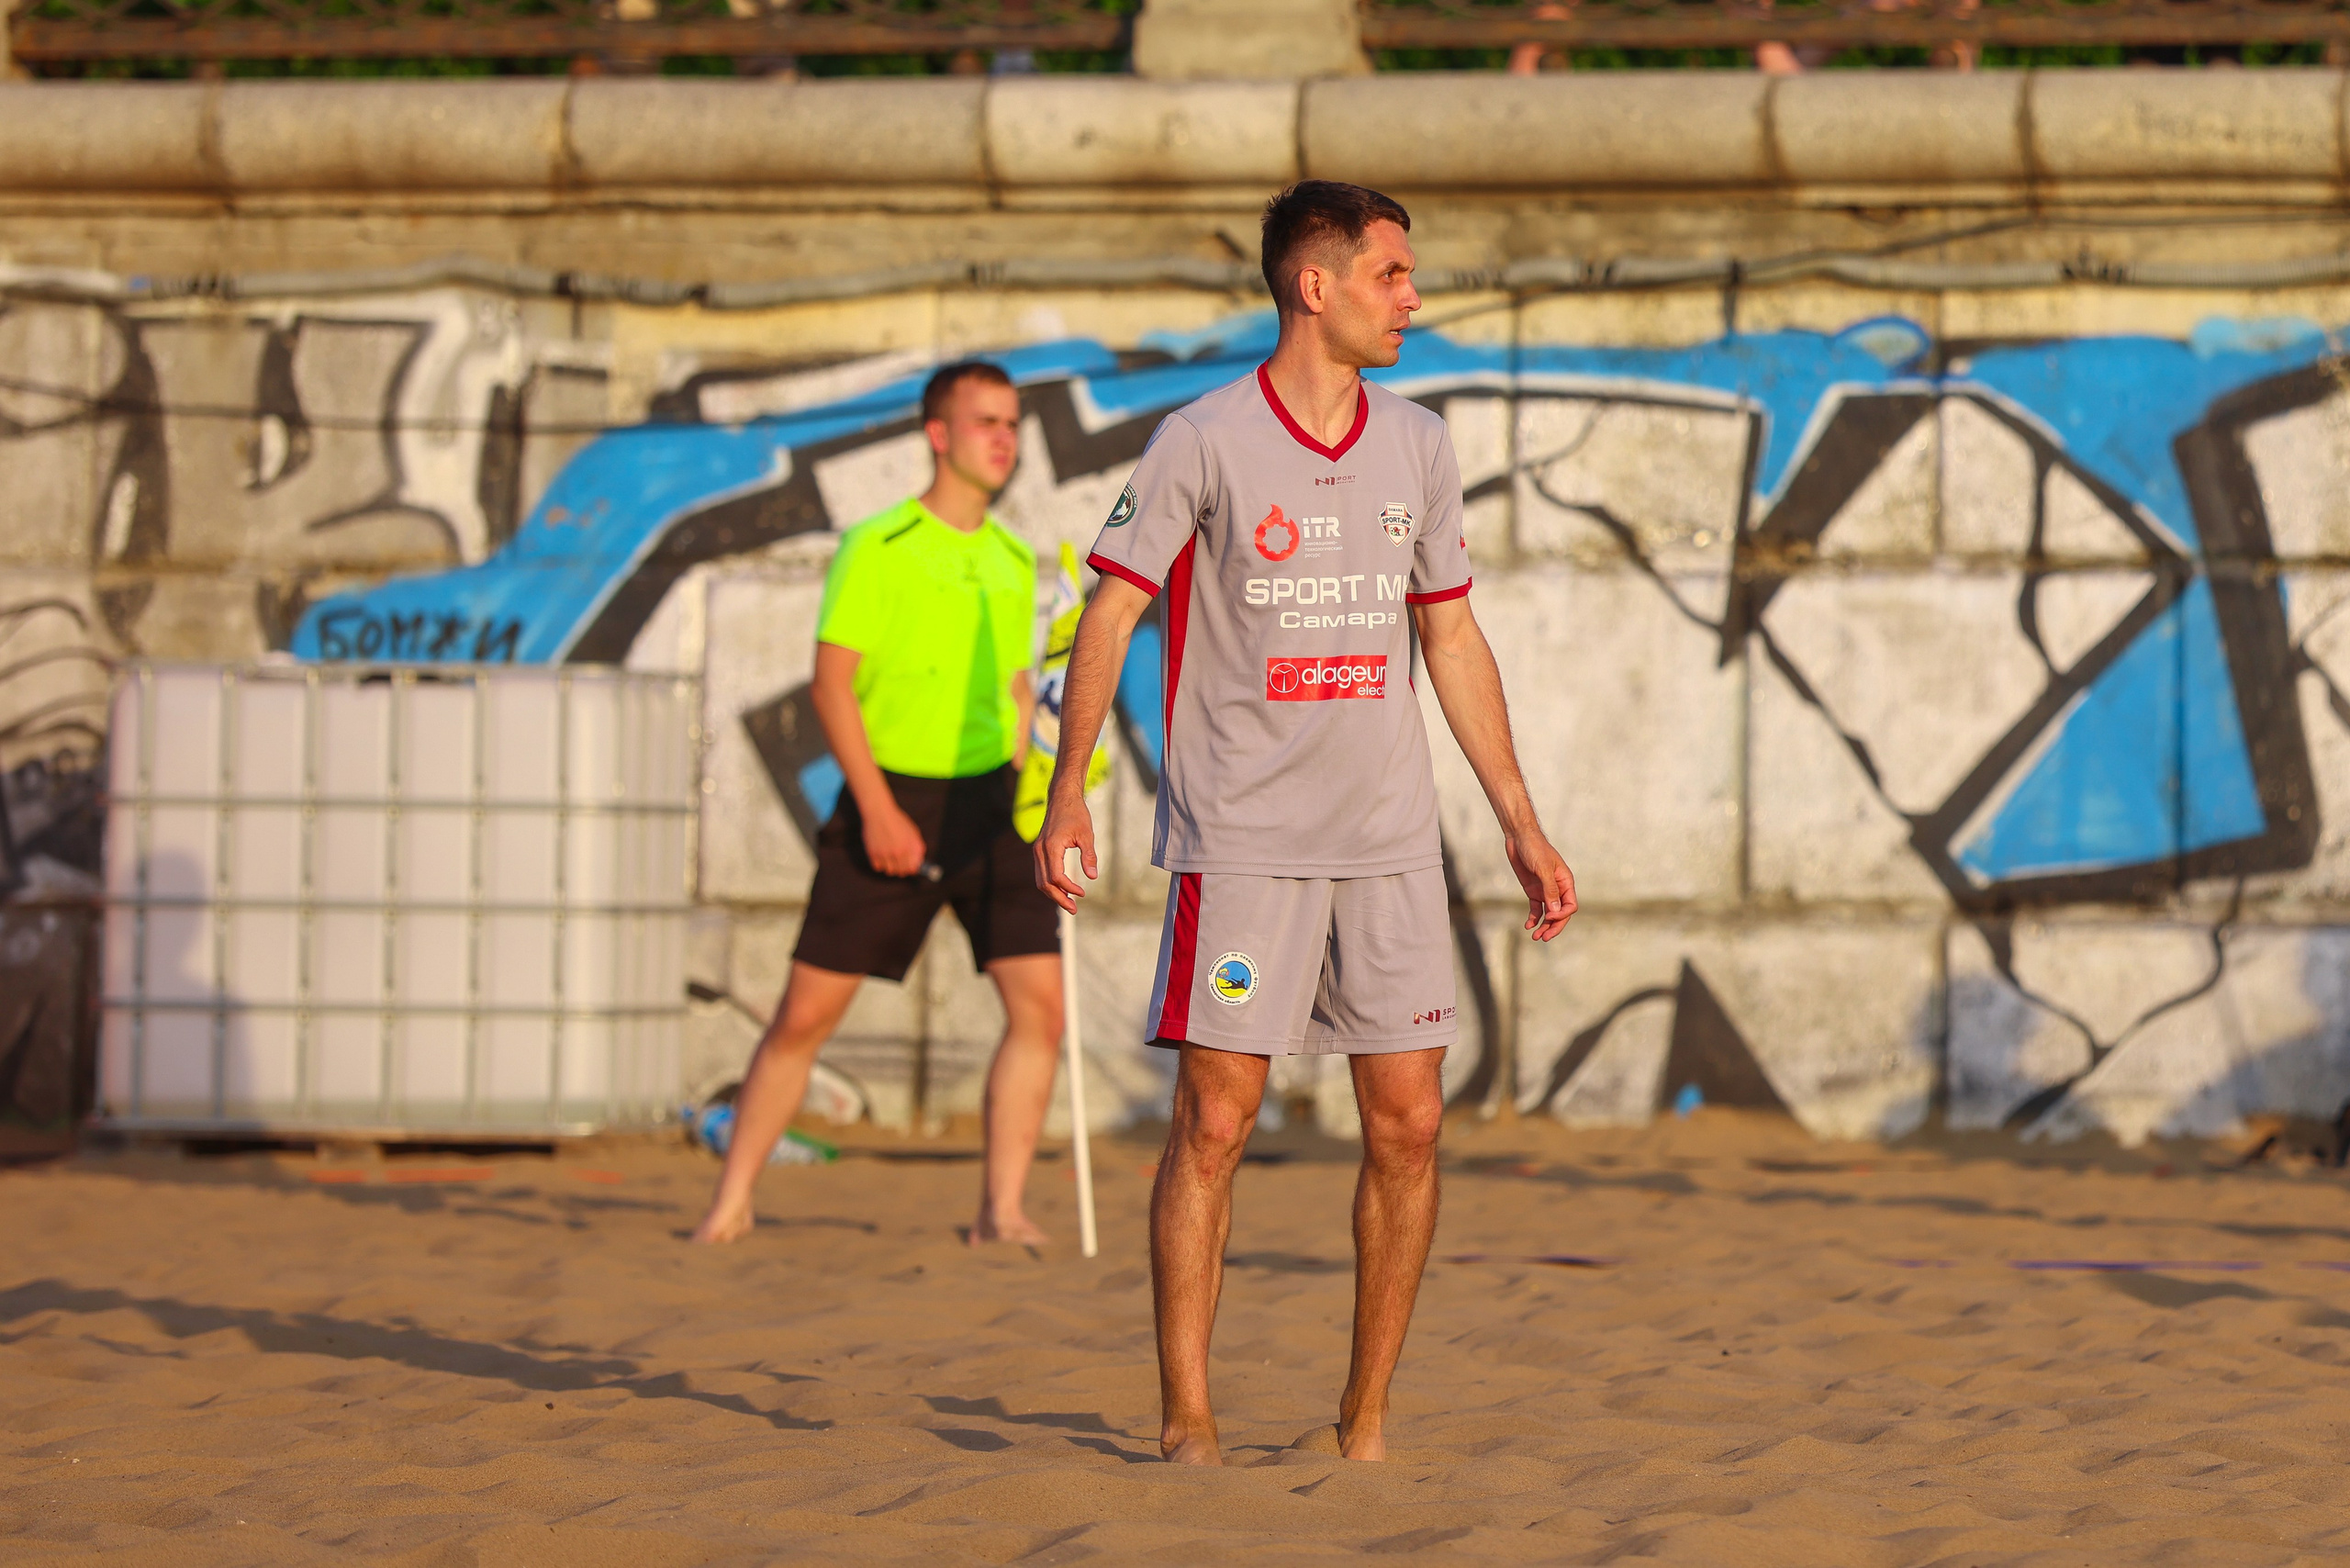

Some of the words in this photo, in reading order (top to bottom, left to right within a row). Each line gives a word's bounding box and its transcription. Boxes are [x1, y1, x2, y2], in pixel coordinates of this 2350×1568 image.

[1245, 574, 1365, 605] SPORT
[1280, 610, 1397, 630] Самара
[1442, 1006, 1457, 1016] SPO
